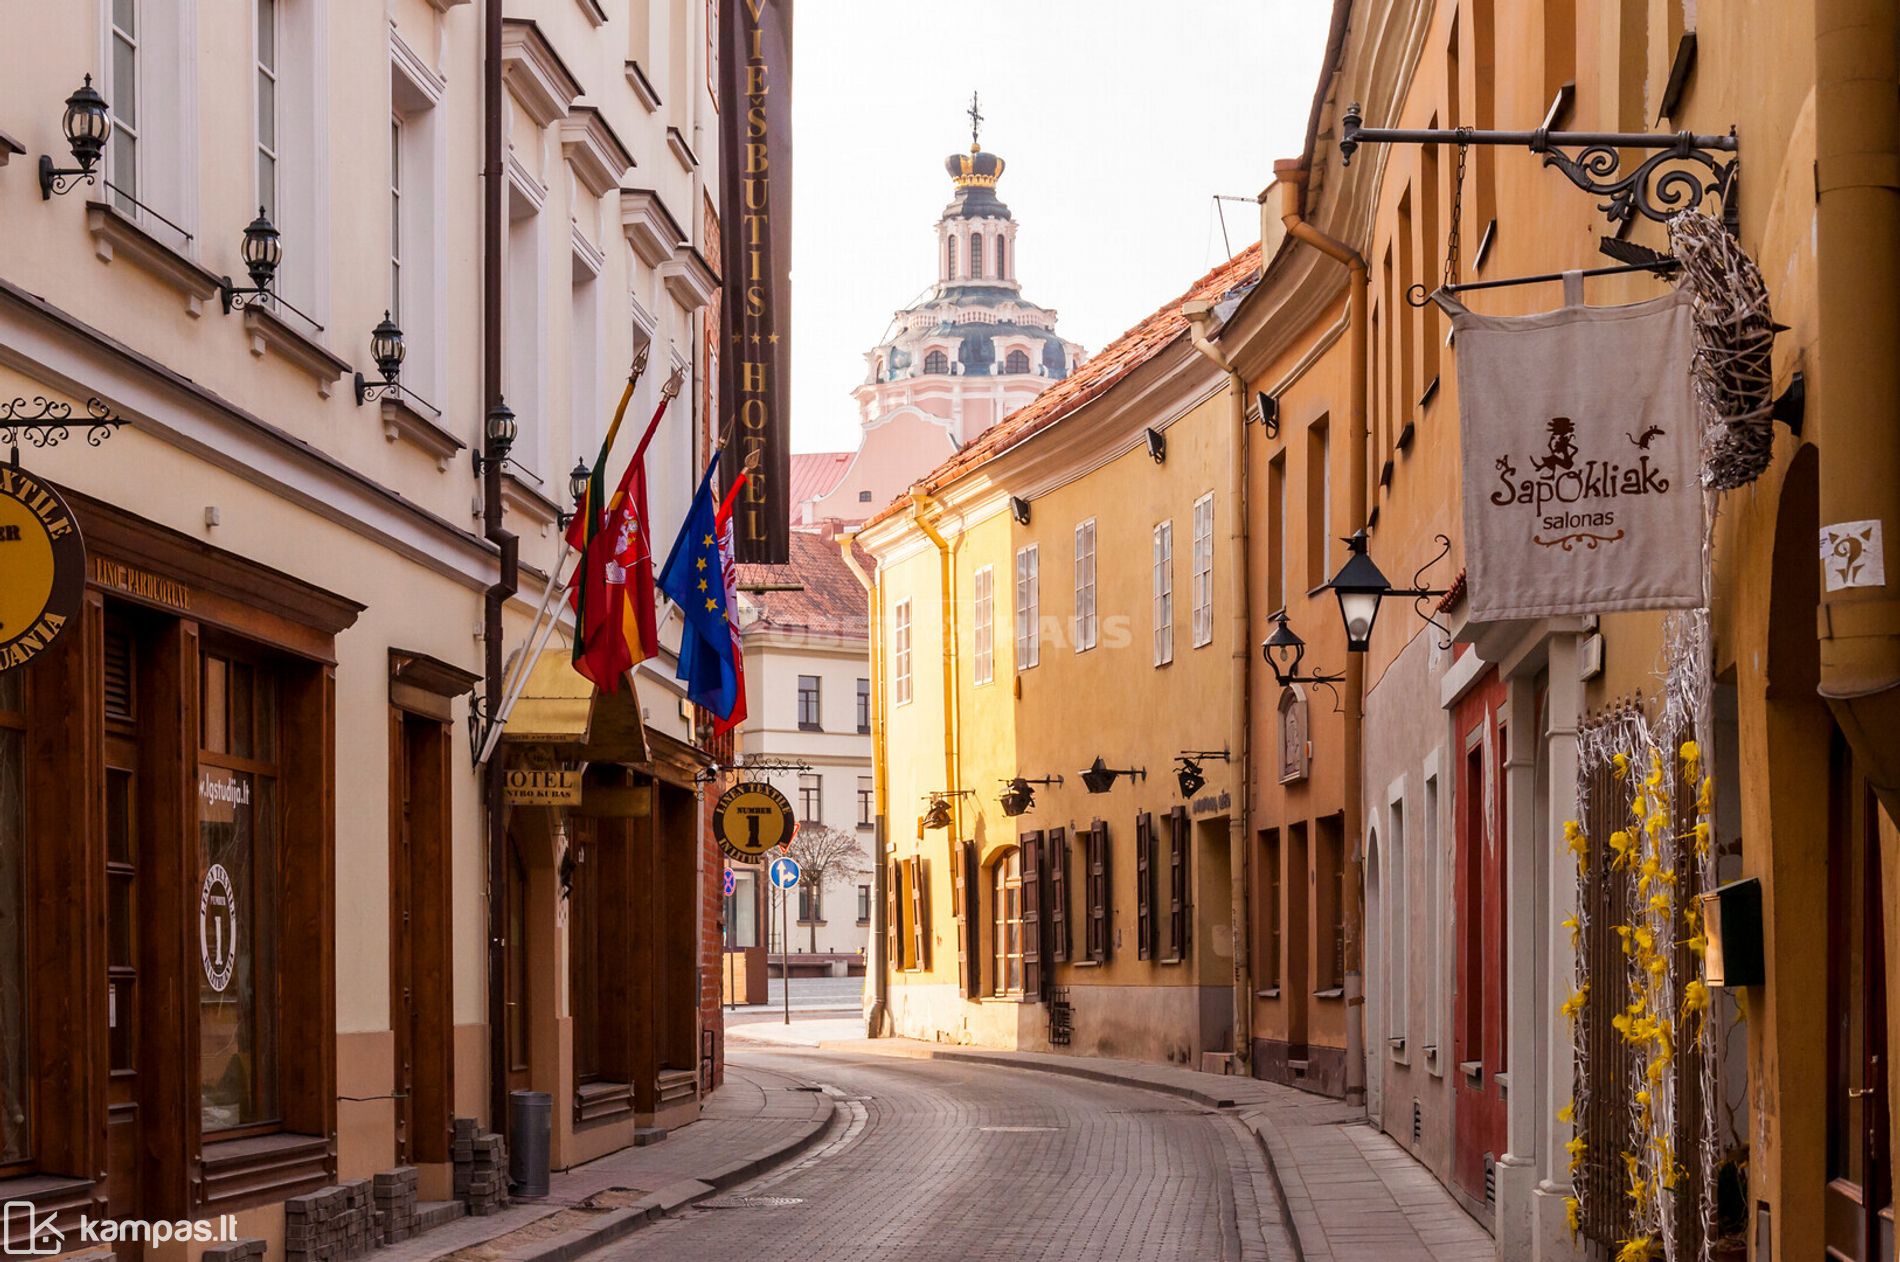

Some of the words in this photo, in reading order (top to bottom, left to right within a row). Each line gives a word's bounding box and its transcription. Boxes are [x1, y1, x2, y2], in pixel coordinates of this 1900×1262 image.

[744, 0, 770, 318] VIEŠBUTIS
[741, 362, 768, 541] HOTEL
[1543, 511, 1614, 530] salonas
[716, 787, 744, 813] LINEN
[749, 783, 790, 814] TEXTILE
[745, 815, 763, 847] 1
